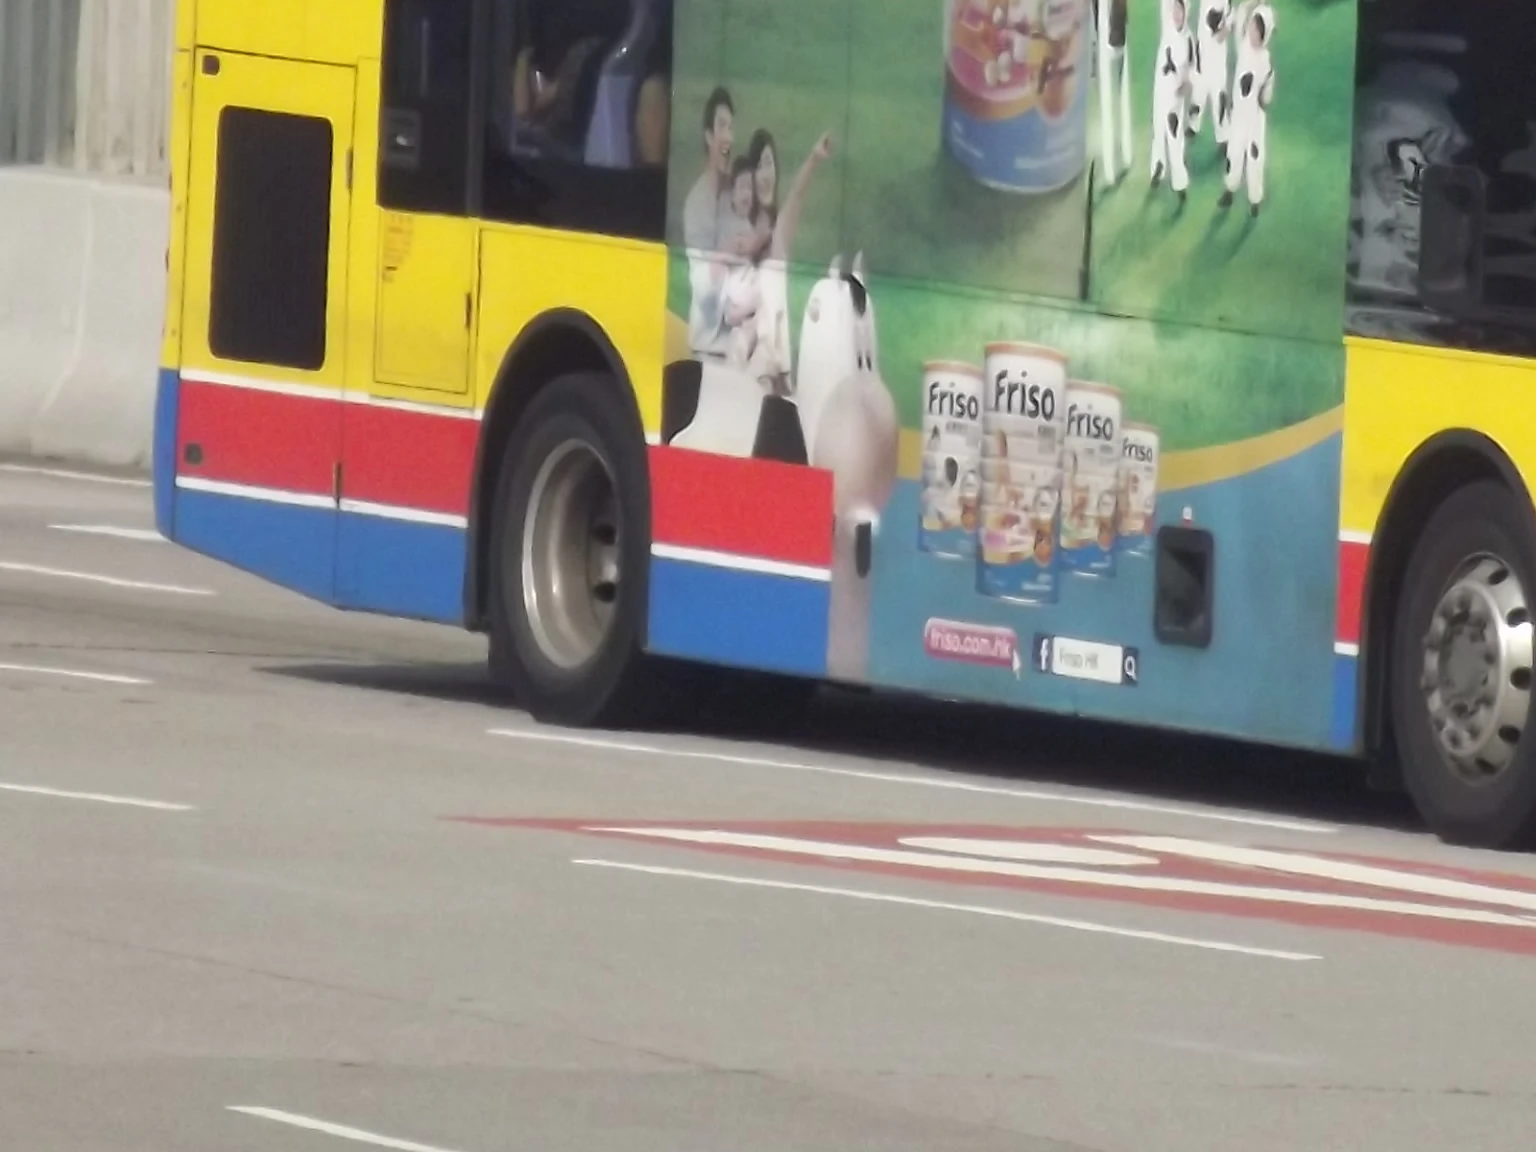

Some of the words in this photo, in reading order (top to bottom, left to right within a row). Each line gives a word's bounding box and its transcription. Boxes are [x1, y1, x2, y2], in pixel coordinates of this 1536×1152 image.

[928, 381, 979, 422] Friso
[994, 368, 1056, 422] Friso
[1066, 404, 1114, 442] Friso
[1122, 437, 1154, 464] Friso
